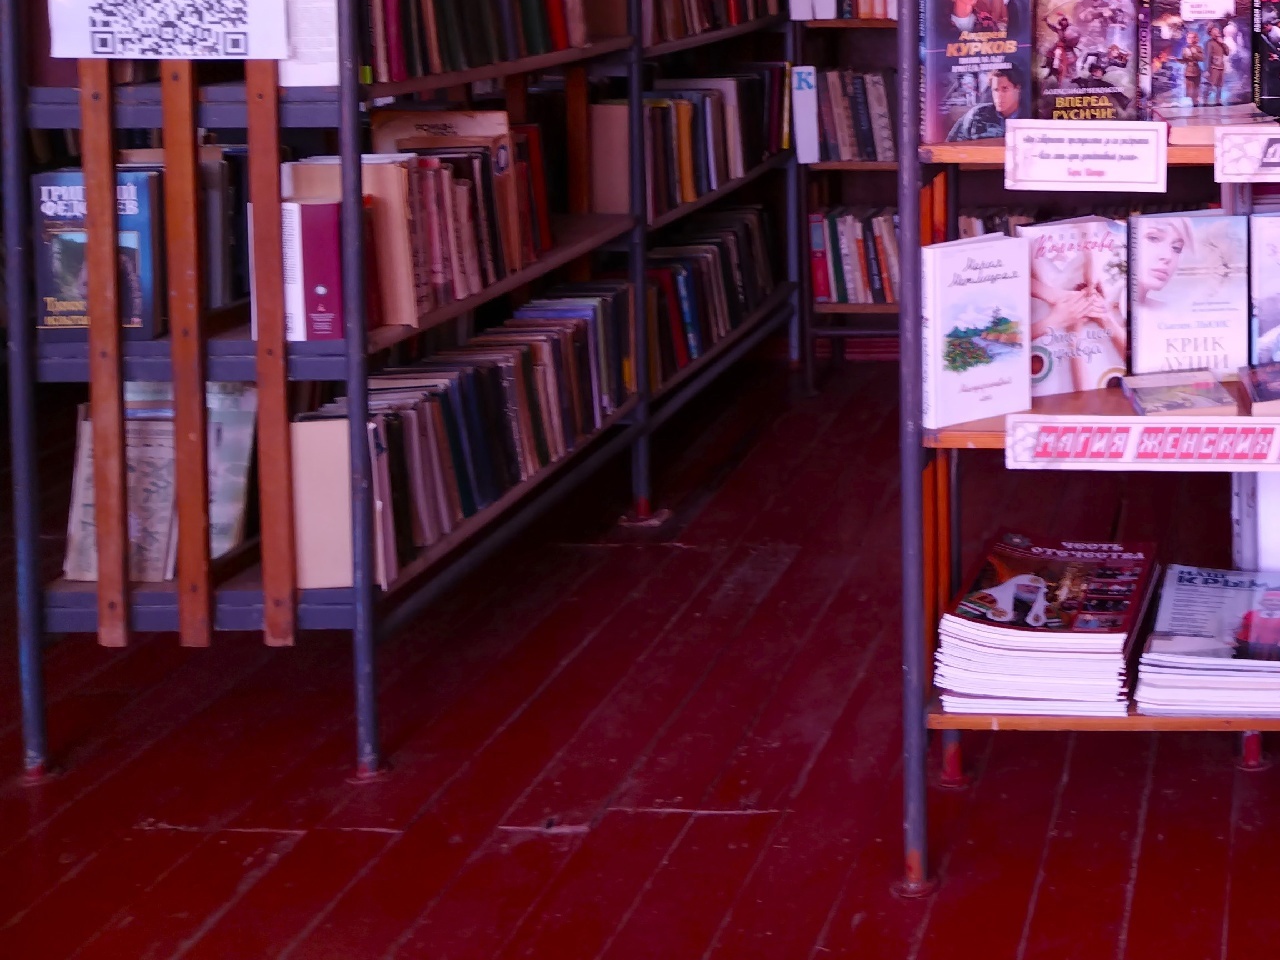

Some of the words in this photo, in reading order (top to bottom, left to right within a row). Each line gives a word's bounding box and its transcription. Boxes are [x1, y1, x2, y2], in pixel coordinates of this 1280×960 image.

[946, 40, 1018, 57] КУРКОВ
[795, 70, 814, 90] К
[1164, 336, 1227, 354] КРИК
[1035, 426, 1132, 458] МАГИЯ
[1135, 427, 1274, 459] ЖЕНСКИХ
[1030, 546, 1146, 560] ОТЕЧЕСТВА
[1061, 540, 1125, 552] ЧЕСТЬ
